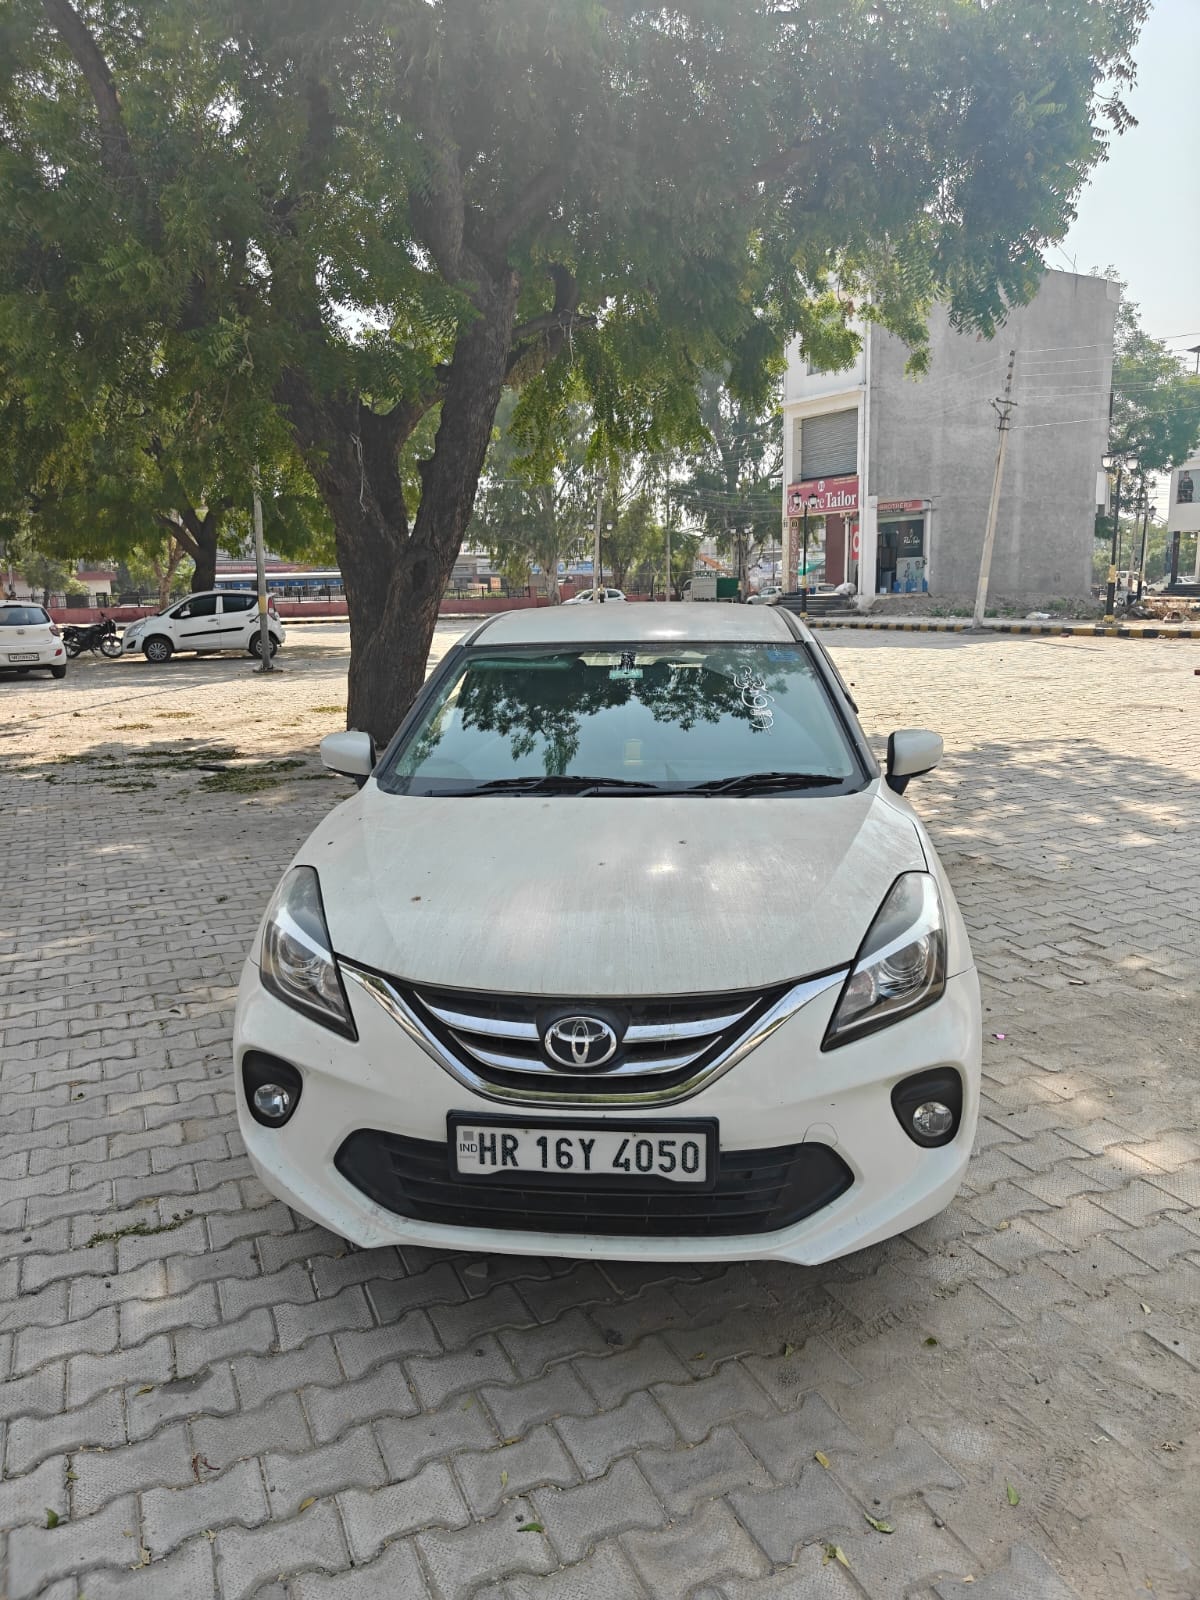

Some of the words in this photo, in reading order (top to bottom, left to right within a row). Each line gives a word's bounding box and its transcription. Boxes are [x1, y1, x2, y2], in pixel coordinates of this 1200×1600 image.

[788, 494, 825, 513] Desre
[825, 490, 857, 508] Tailor
[460, 1143, 478, 1153] IND
[479, 1132, 519, 1167] HR
[536, 1136, 595, 1170] 16Y
[612, 1138, 700, 1174] 4050
